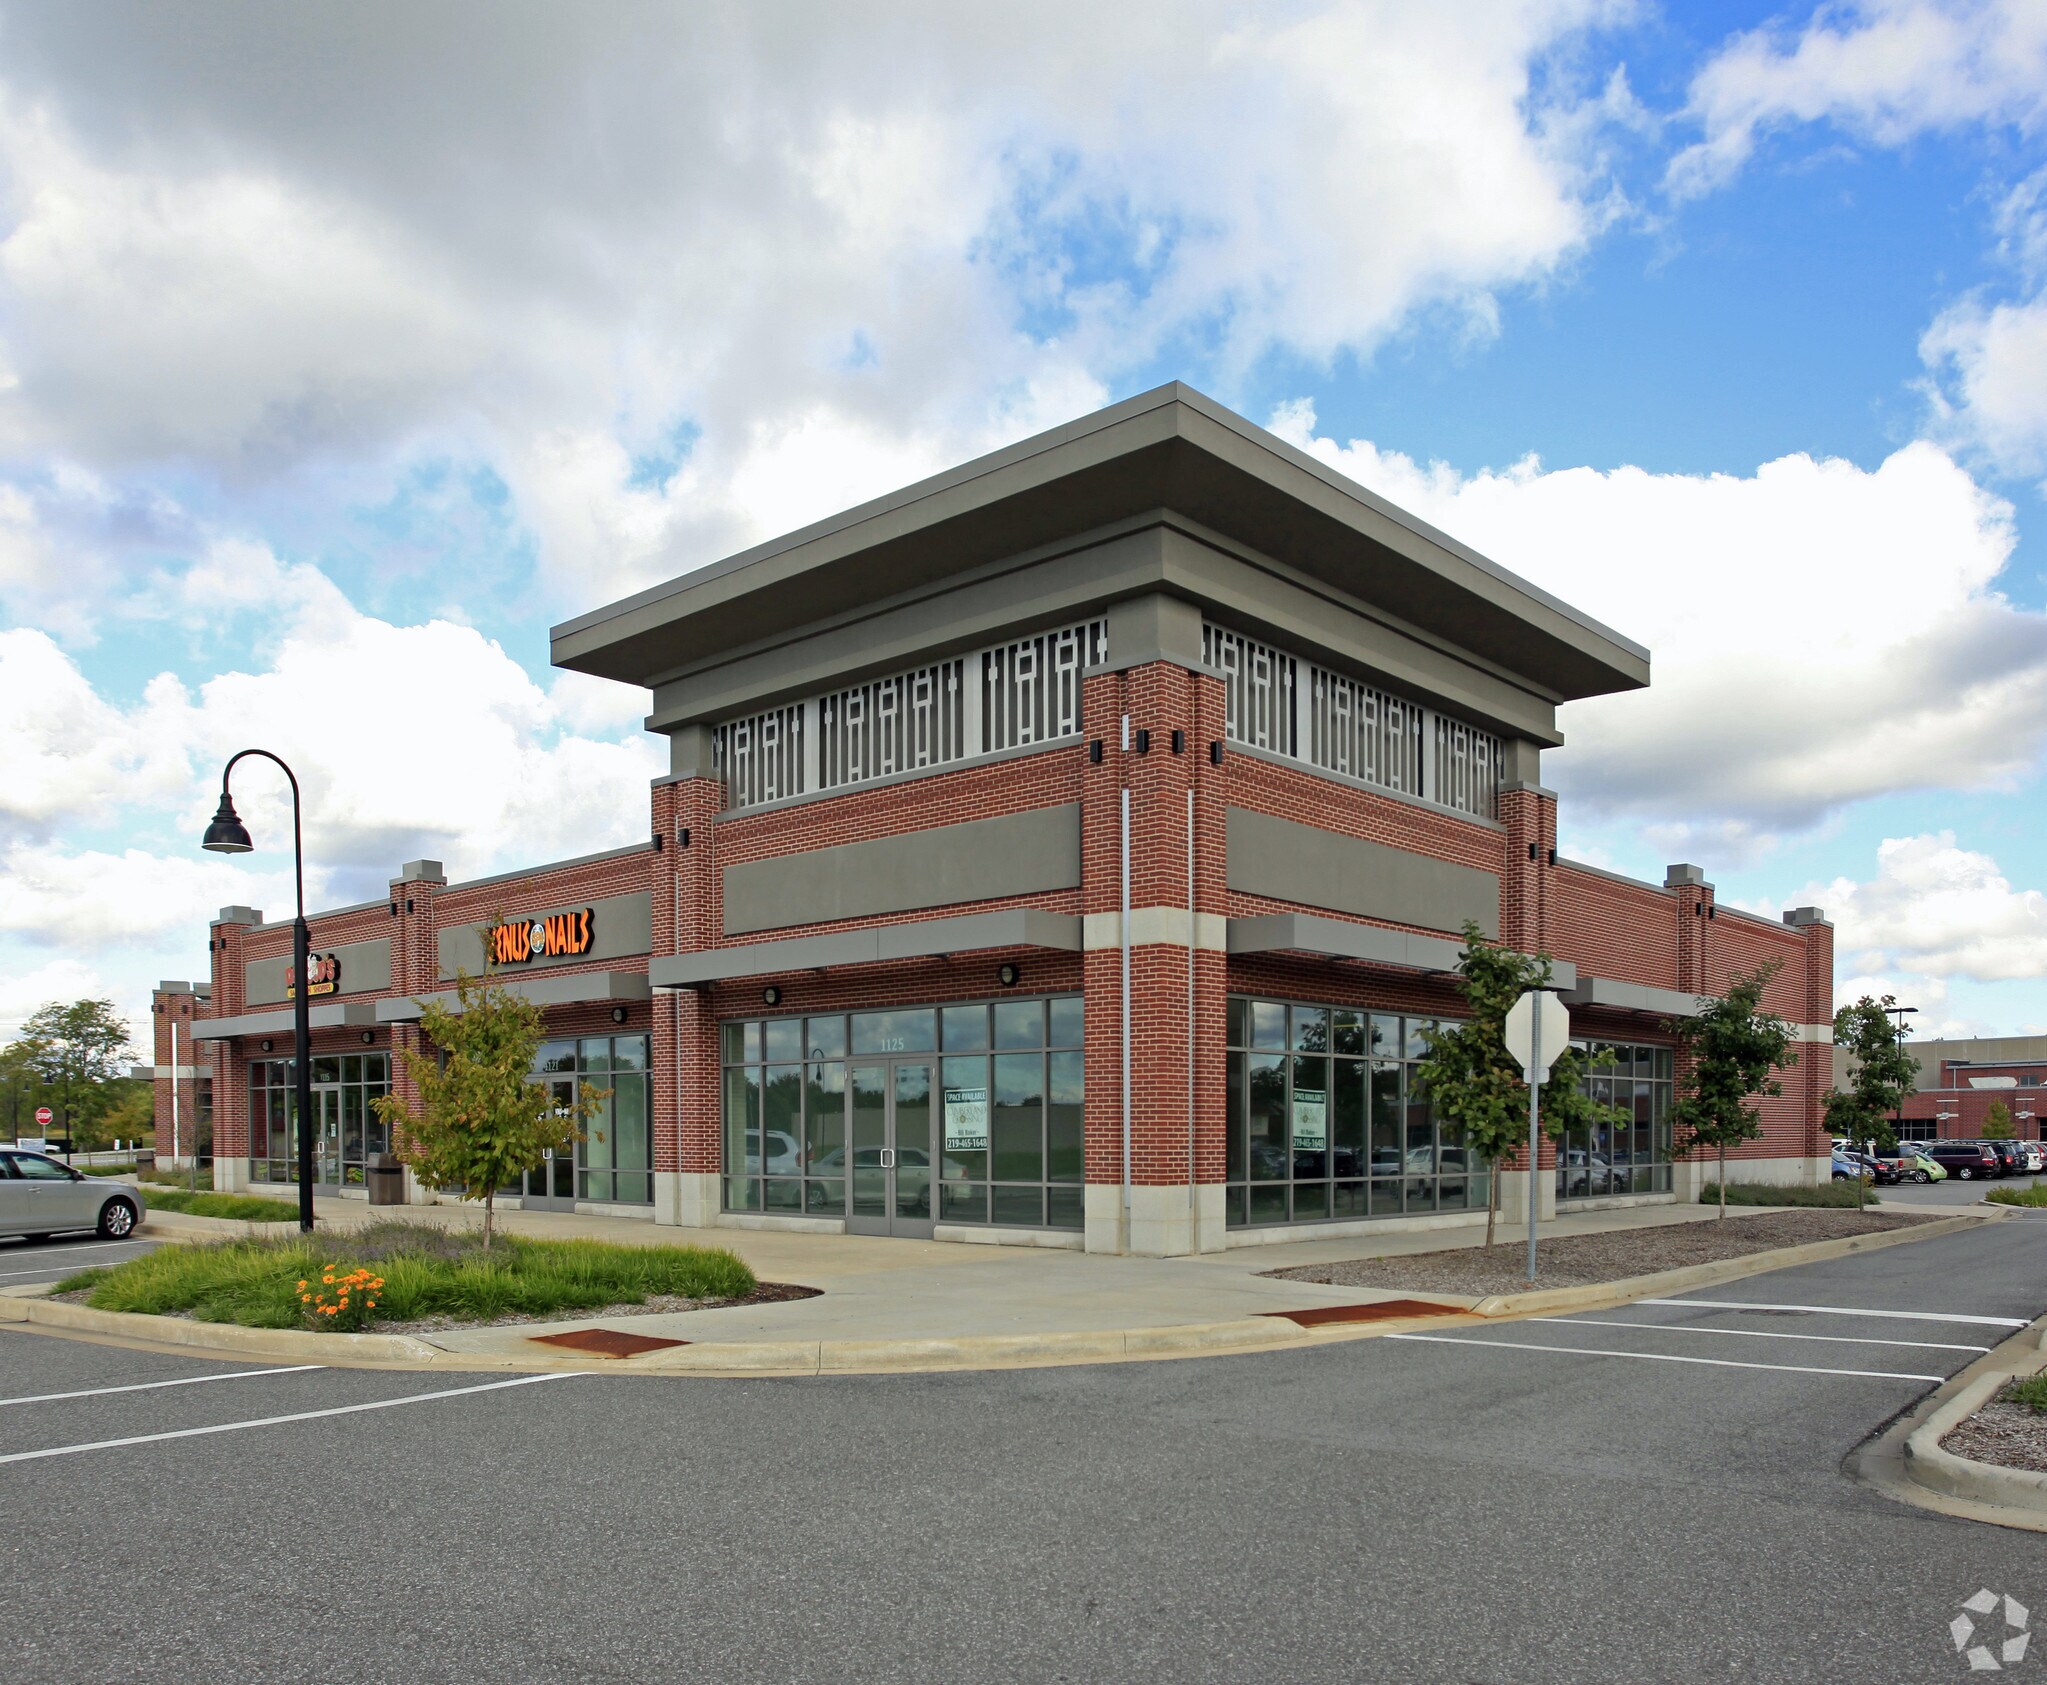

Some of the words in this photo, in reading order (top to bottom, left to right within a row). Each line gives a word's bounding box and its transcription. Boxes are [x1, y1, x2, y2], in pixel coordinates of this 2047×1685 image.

[545, 908, 592, 957] NAILS
[881, 1037, 904, 1051] 1125
[947, 1092, 961, 1102] SPACE
[961, 1090, 986, 1101] AVAILABLE
[37, 1112, 53, 1120] STOP
[947, 1137, 988, 1149] 219-465-1648
